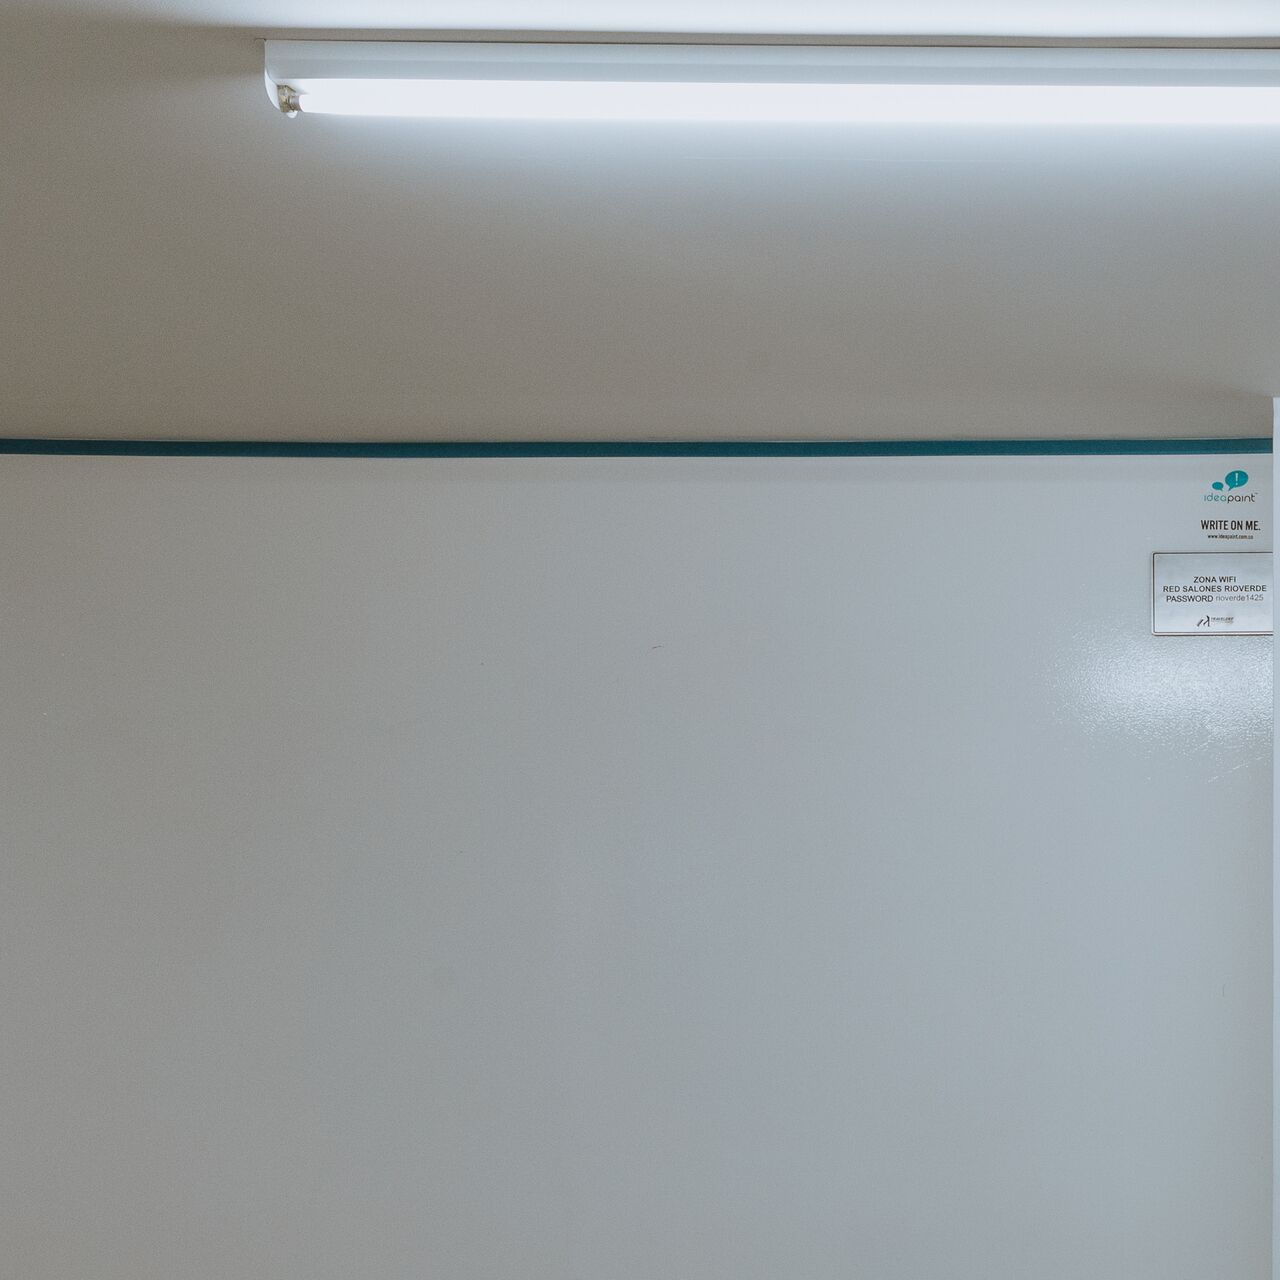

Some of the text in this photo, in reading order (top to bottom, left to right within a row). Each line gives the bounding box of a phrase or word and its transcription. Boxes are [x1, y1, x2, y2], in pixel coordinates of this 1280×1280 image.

[1203, 492, 1256, 504] ideapaint
[1200, 519, 1261, 531] WRITE ON ME.
[1163, 584, 1267, 593] RED SALONES RIOVERDE
[1166, 595, 1214, 603] PASSWORD
